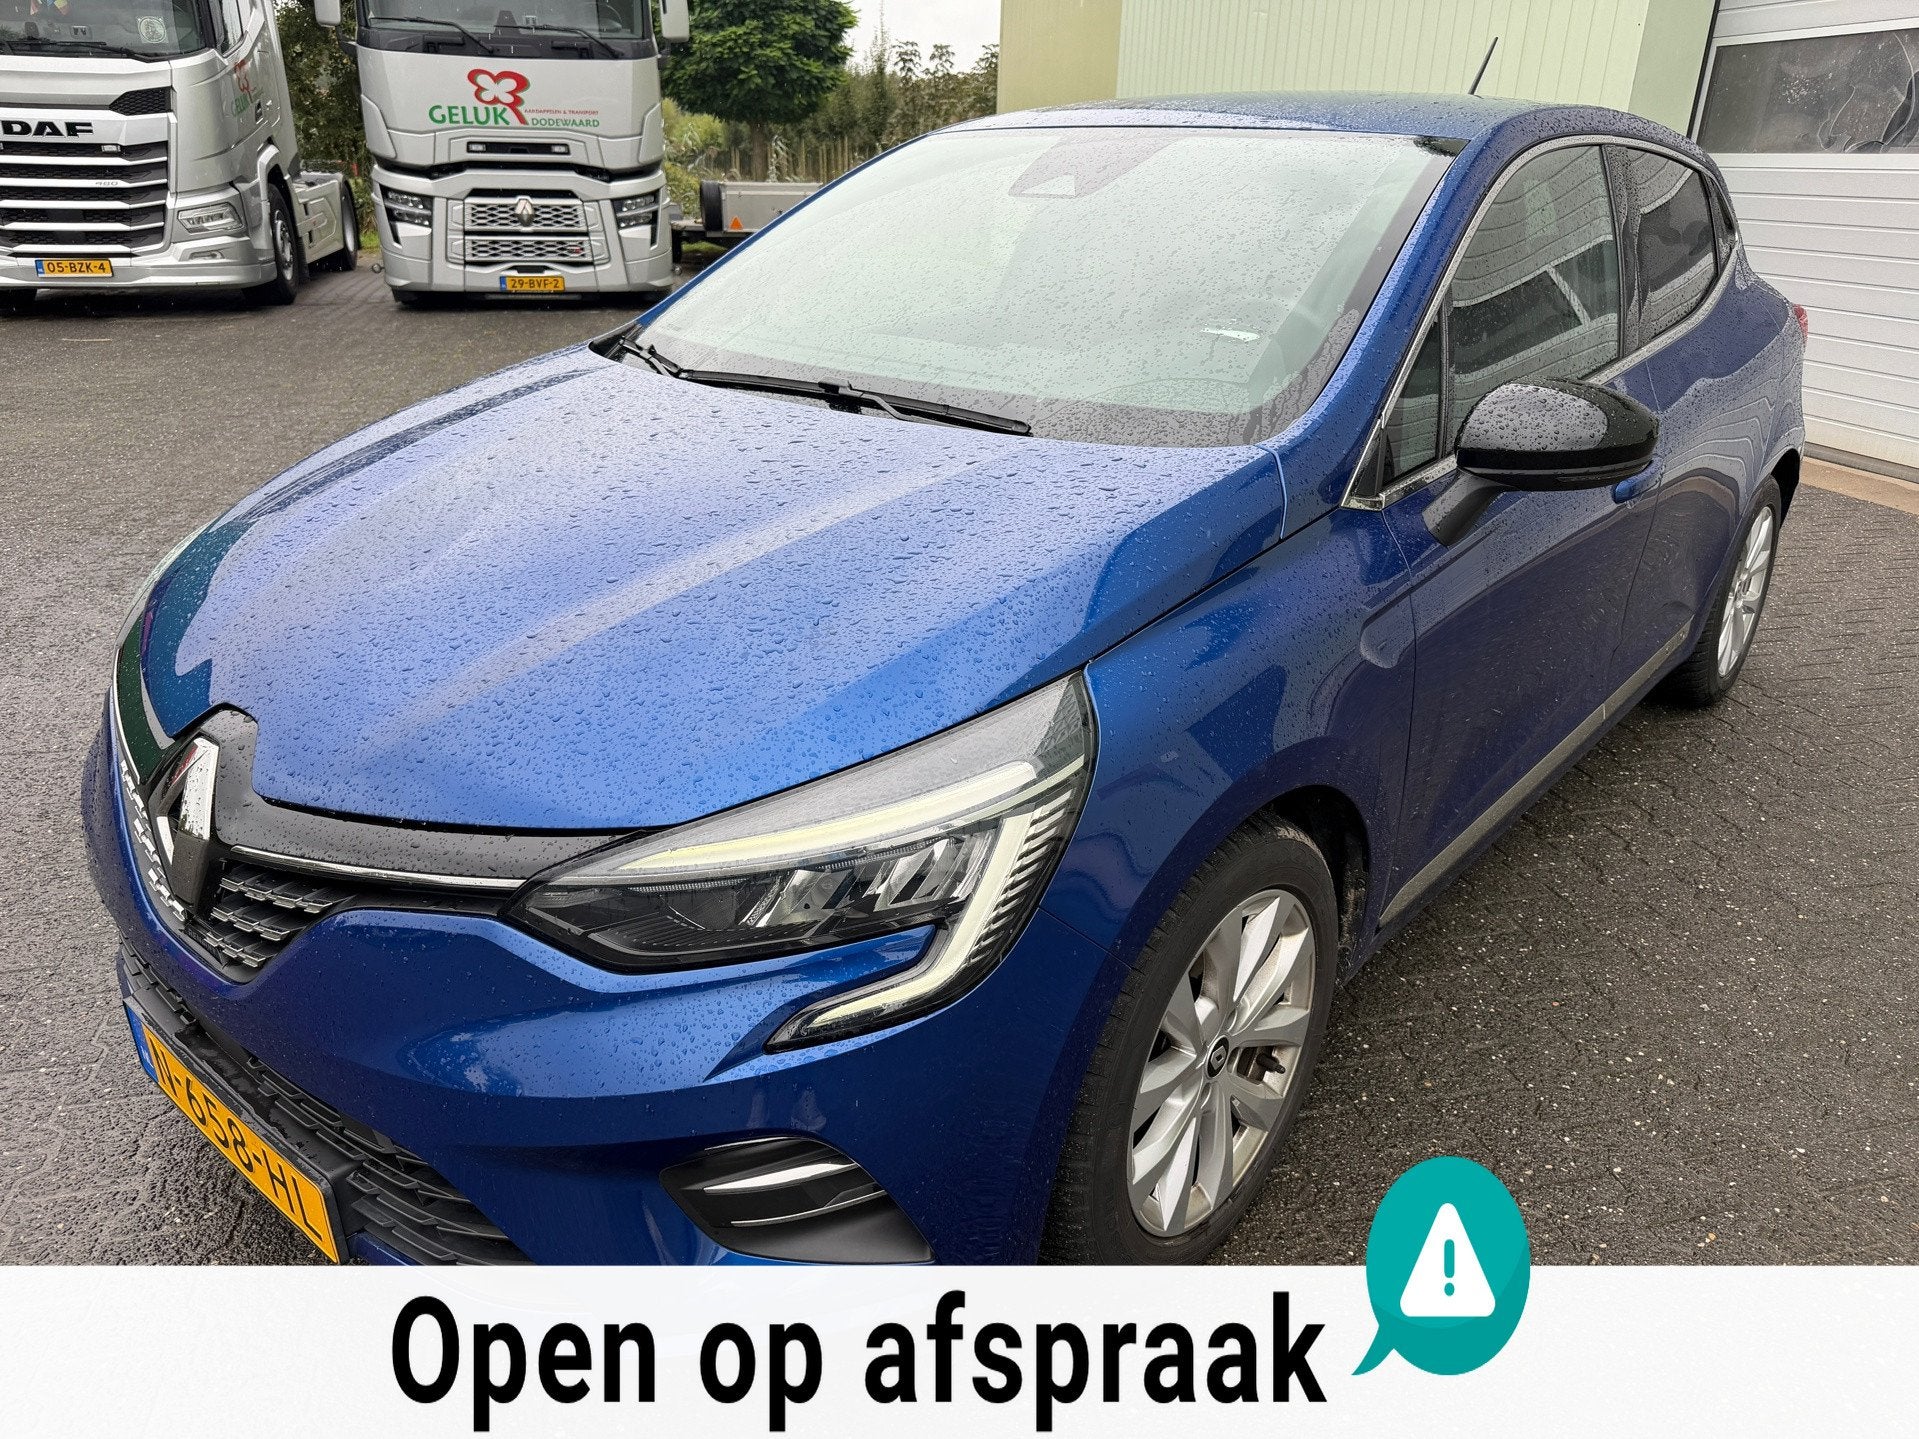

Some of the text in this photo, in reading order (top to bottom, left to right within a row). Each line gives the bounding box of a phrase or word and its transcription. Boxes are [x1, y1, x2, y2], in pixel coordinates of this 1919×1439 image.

[428, 104, 511, 126] GELUK
[531, 117, 600, 128] DODEWAARD
[1, 120, 93, 138] DAF
[46, 261, 106, 274] 05-BZK-4
[510, 278, 560, 289] 29-BVF-2
[149, 1036, 323, 1243] N-658-HL
